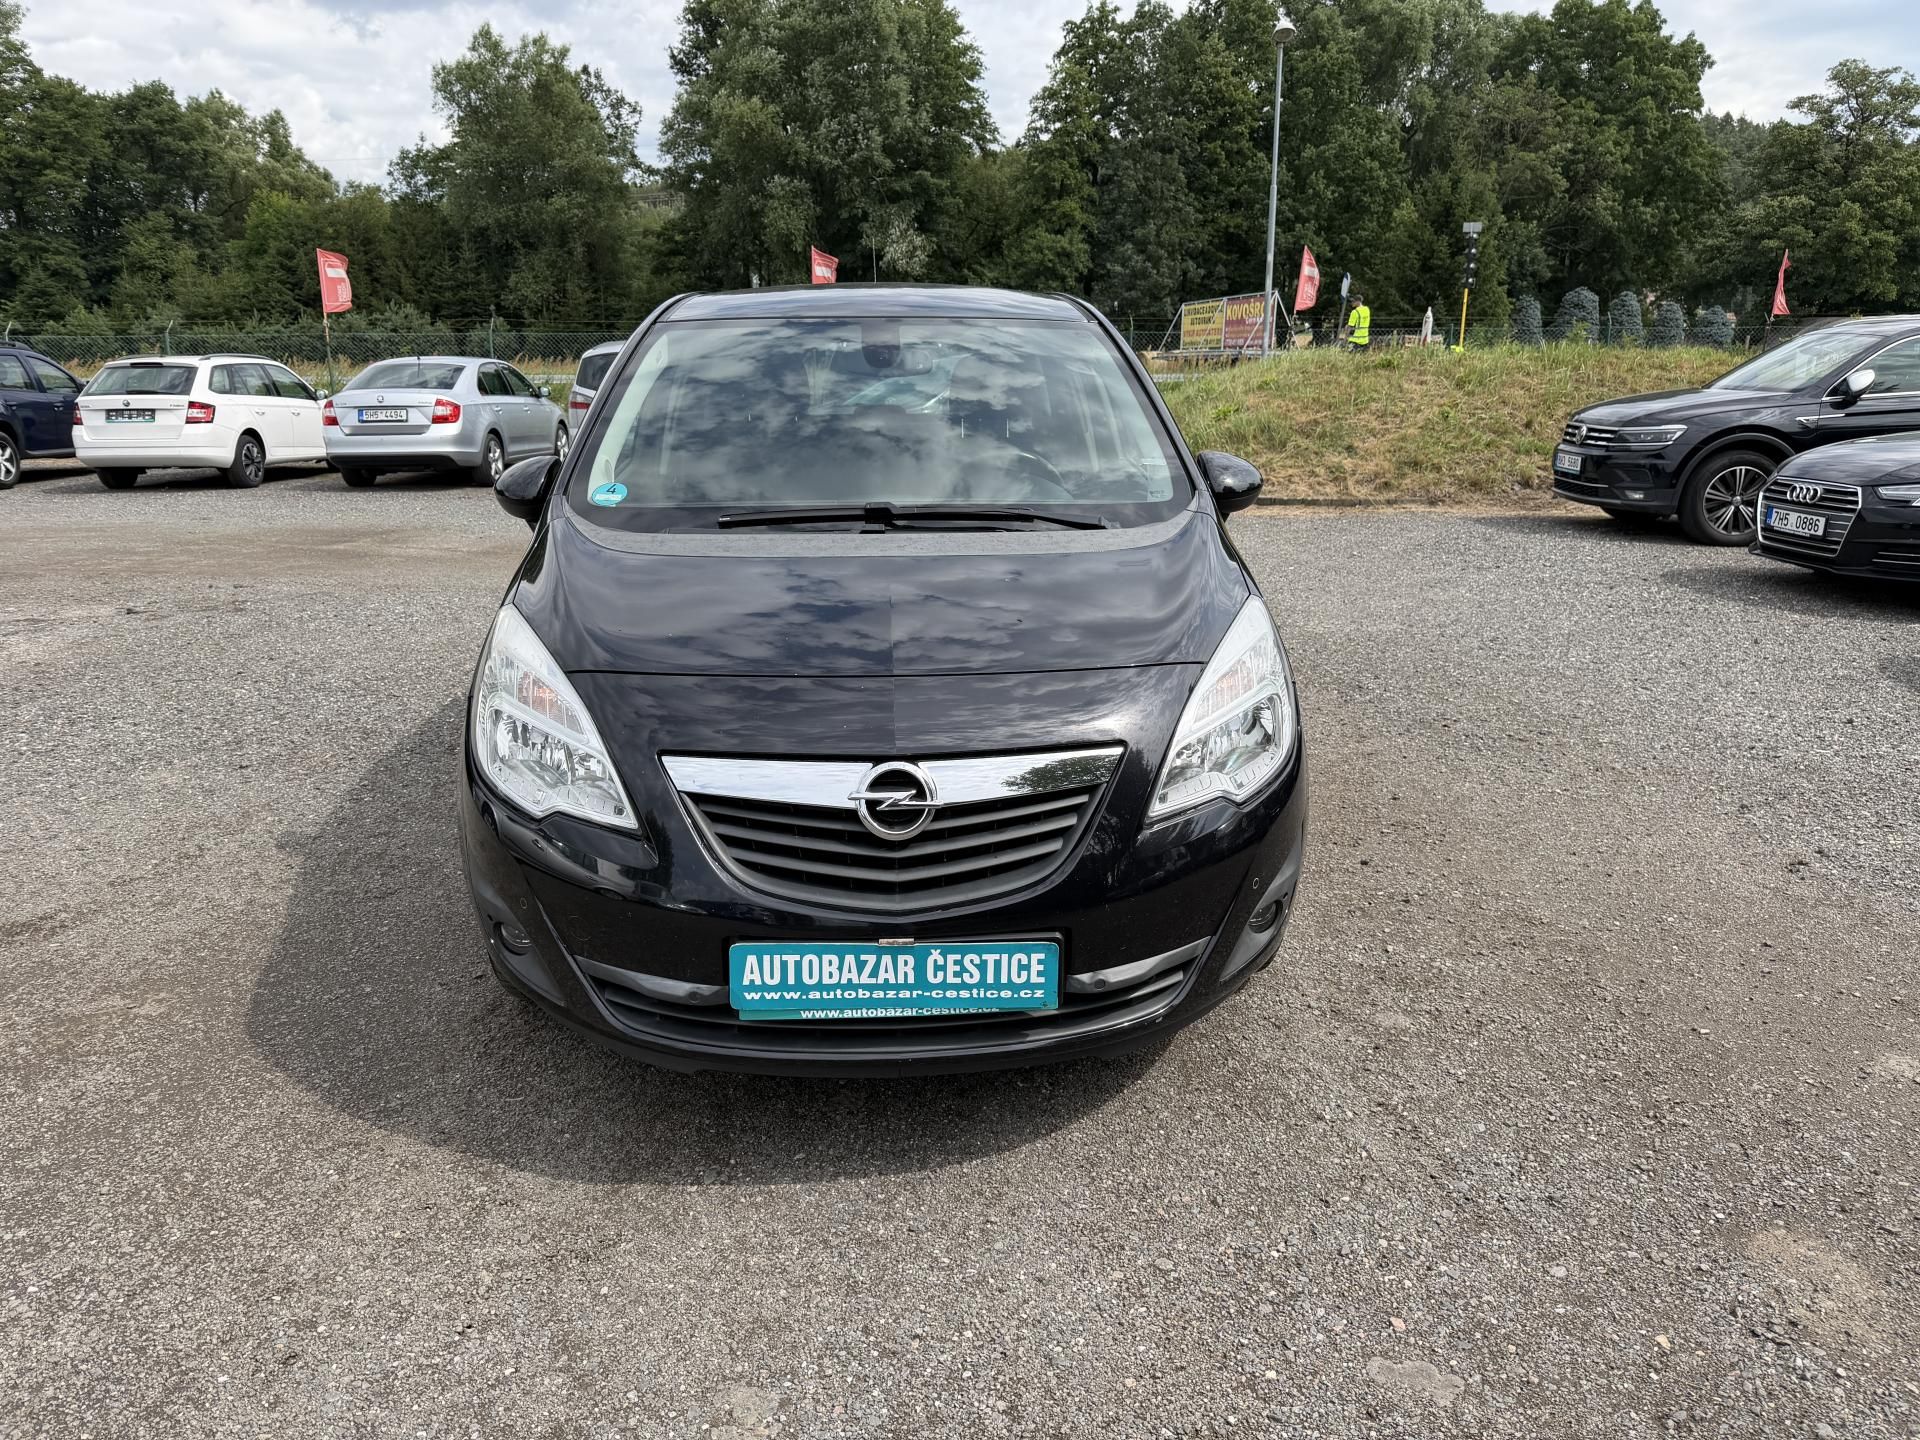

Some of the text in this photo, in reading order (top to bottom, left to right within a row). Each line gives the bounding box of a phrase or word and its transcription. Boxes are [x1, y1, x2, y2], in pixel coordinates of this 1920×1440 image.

[364, 410, 403, 419] 5H5 4494
[606, 483, 617, 494] 4
[1773, 511, 1790, 527] 7H5
[1795, 515, 1820, 533] 0886
[742, 949, 1046, 985] AUTOBAZAR ČESTICE
[743, 988, 1045, 1000] www.autobazar-cestice.cz
